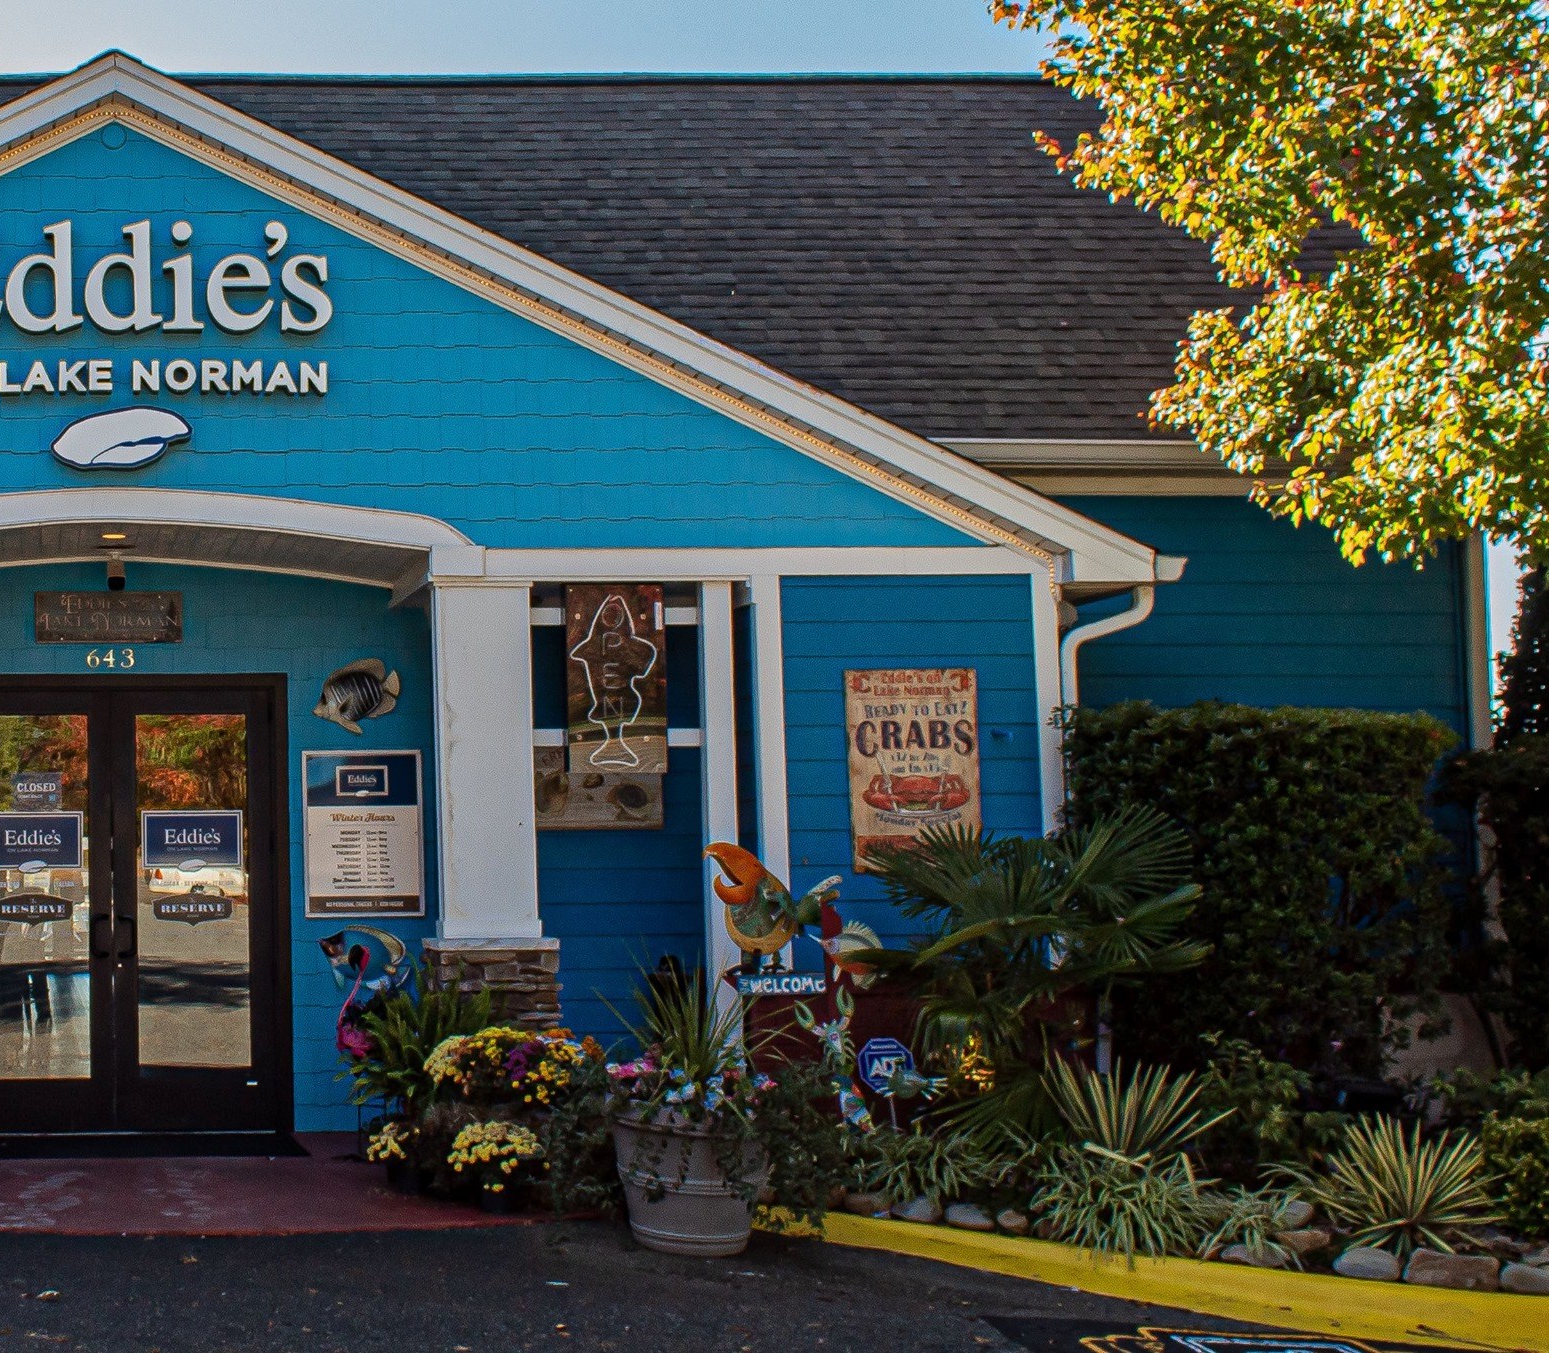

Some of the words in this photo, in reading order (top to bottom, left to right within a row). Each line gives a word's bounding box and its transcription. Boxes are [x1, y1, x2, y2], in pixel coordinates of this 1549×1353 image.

[132, 360, 328, 395] NORMAN
[86, 648, 135, 669] 643
[601, 603, 626, 719] OPEN
[855, 719, 975, 758] CRABS
[16, 782, 56, 793] CLOSED
[330, 812, 363, 822] Winter
[4, 829, 62, 846] Eddie's
[163, 828, 221, 845] Eddie's
[1, 904, 66, 914] RESERVE
[160, 903, 225, 914] RESERVE
